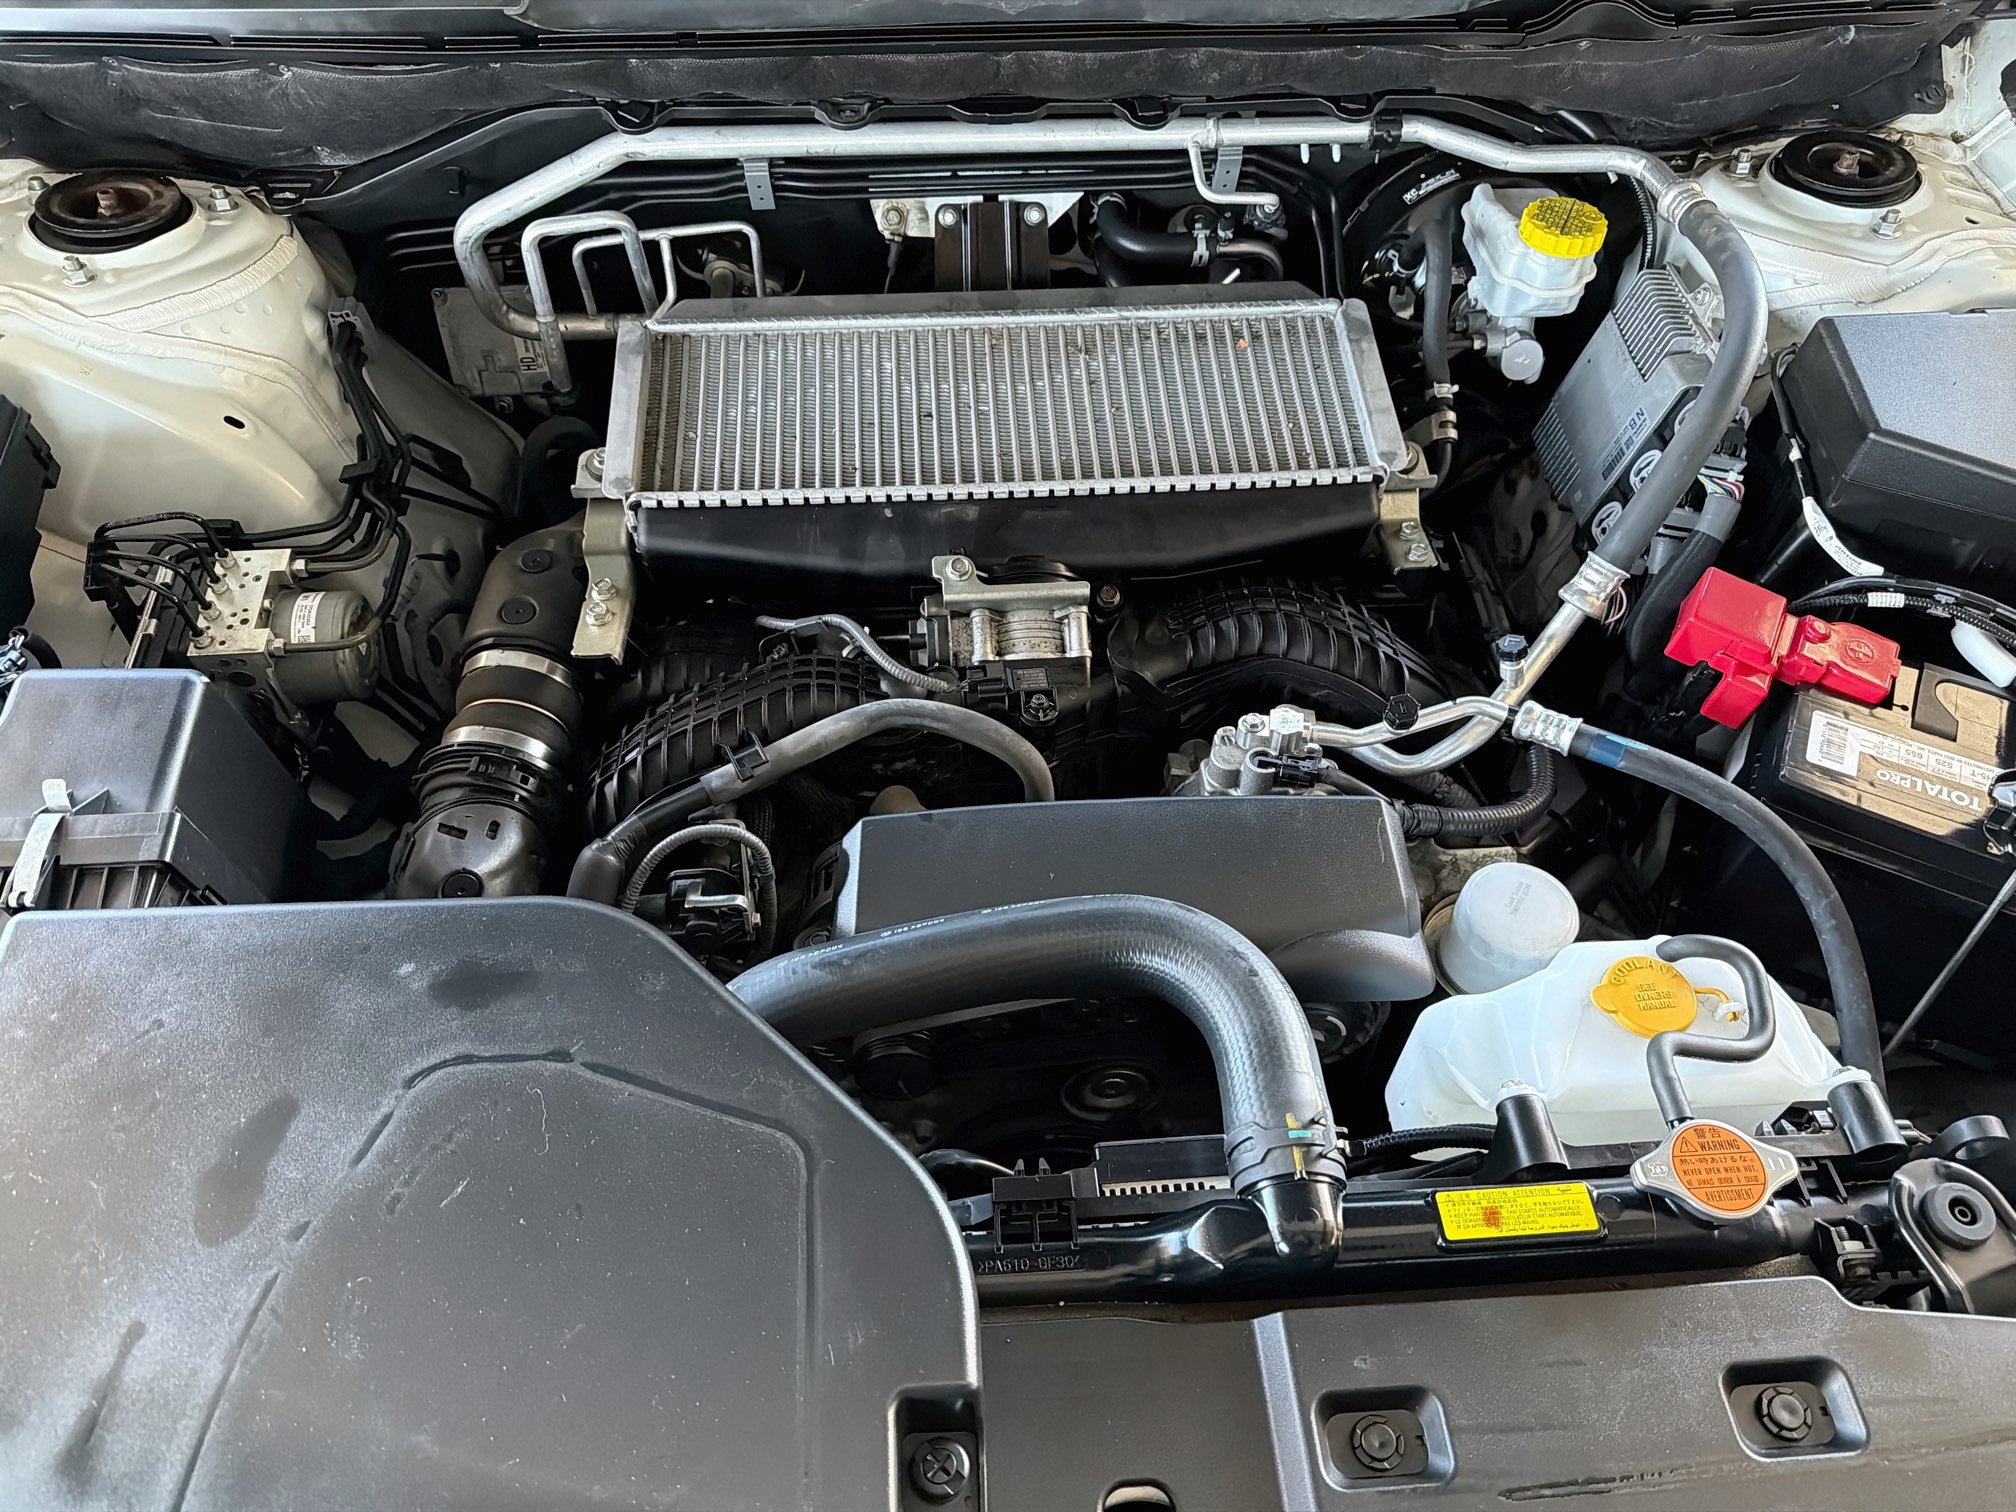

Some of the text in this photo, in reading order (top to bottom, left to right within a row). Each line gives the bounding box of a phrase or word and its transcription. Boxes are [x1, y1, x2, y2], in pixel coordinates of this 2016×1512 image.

[520, 356, 538, 372] HD
[1905, 749, 1923, 760] 655
[1935, 758, 1953, 769] 525
[1876, 769, 1982, 811] TOTALPRO
[1610, 958, 1680, 985] COOLANT
[1637, 982, 1657, 991] SEE
[1635, 990, 1673, 1002] OWNERS
[1638, 999, 1677, 1011] MANUAL
[1693, 1127, 1722, 1140] 警告
[1697, 1138, 1741, 1152] WARNING
[1682, 1164, 1759, 1176] NEVER OPEN WHEN HOT.
[1476, 1187, 1550, 1200] CAUTION ATTENTION
